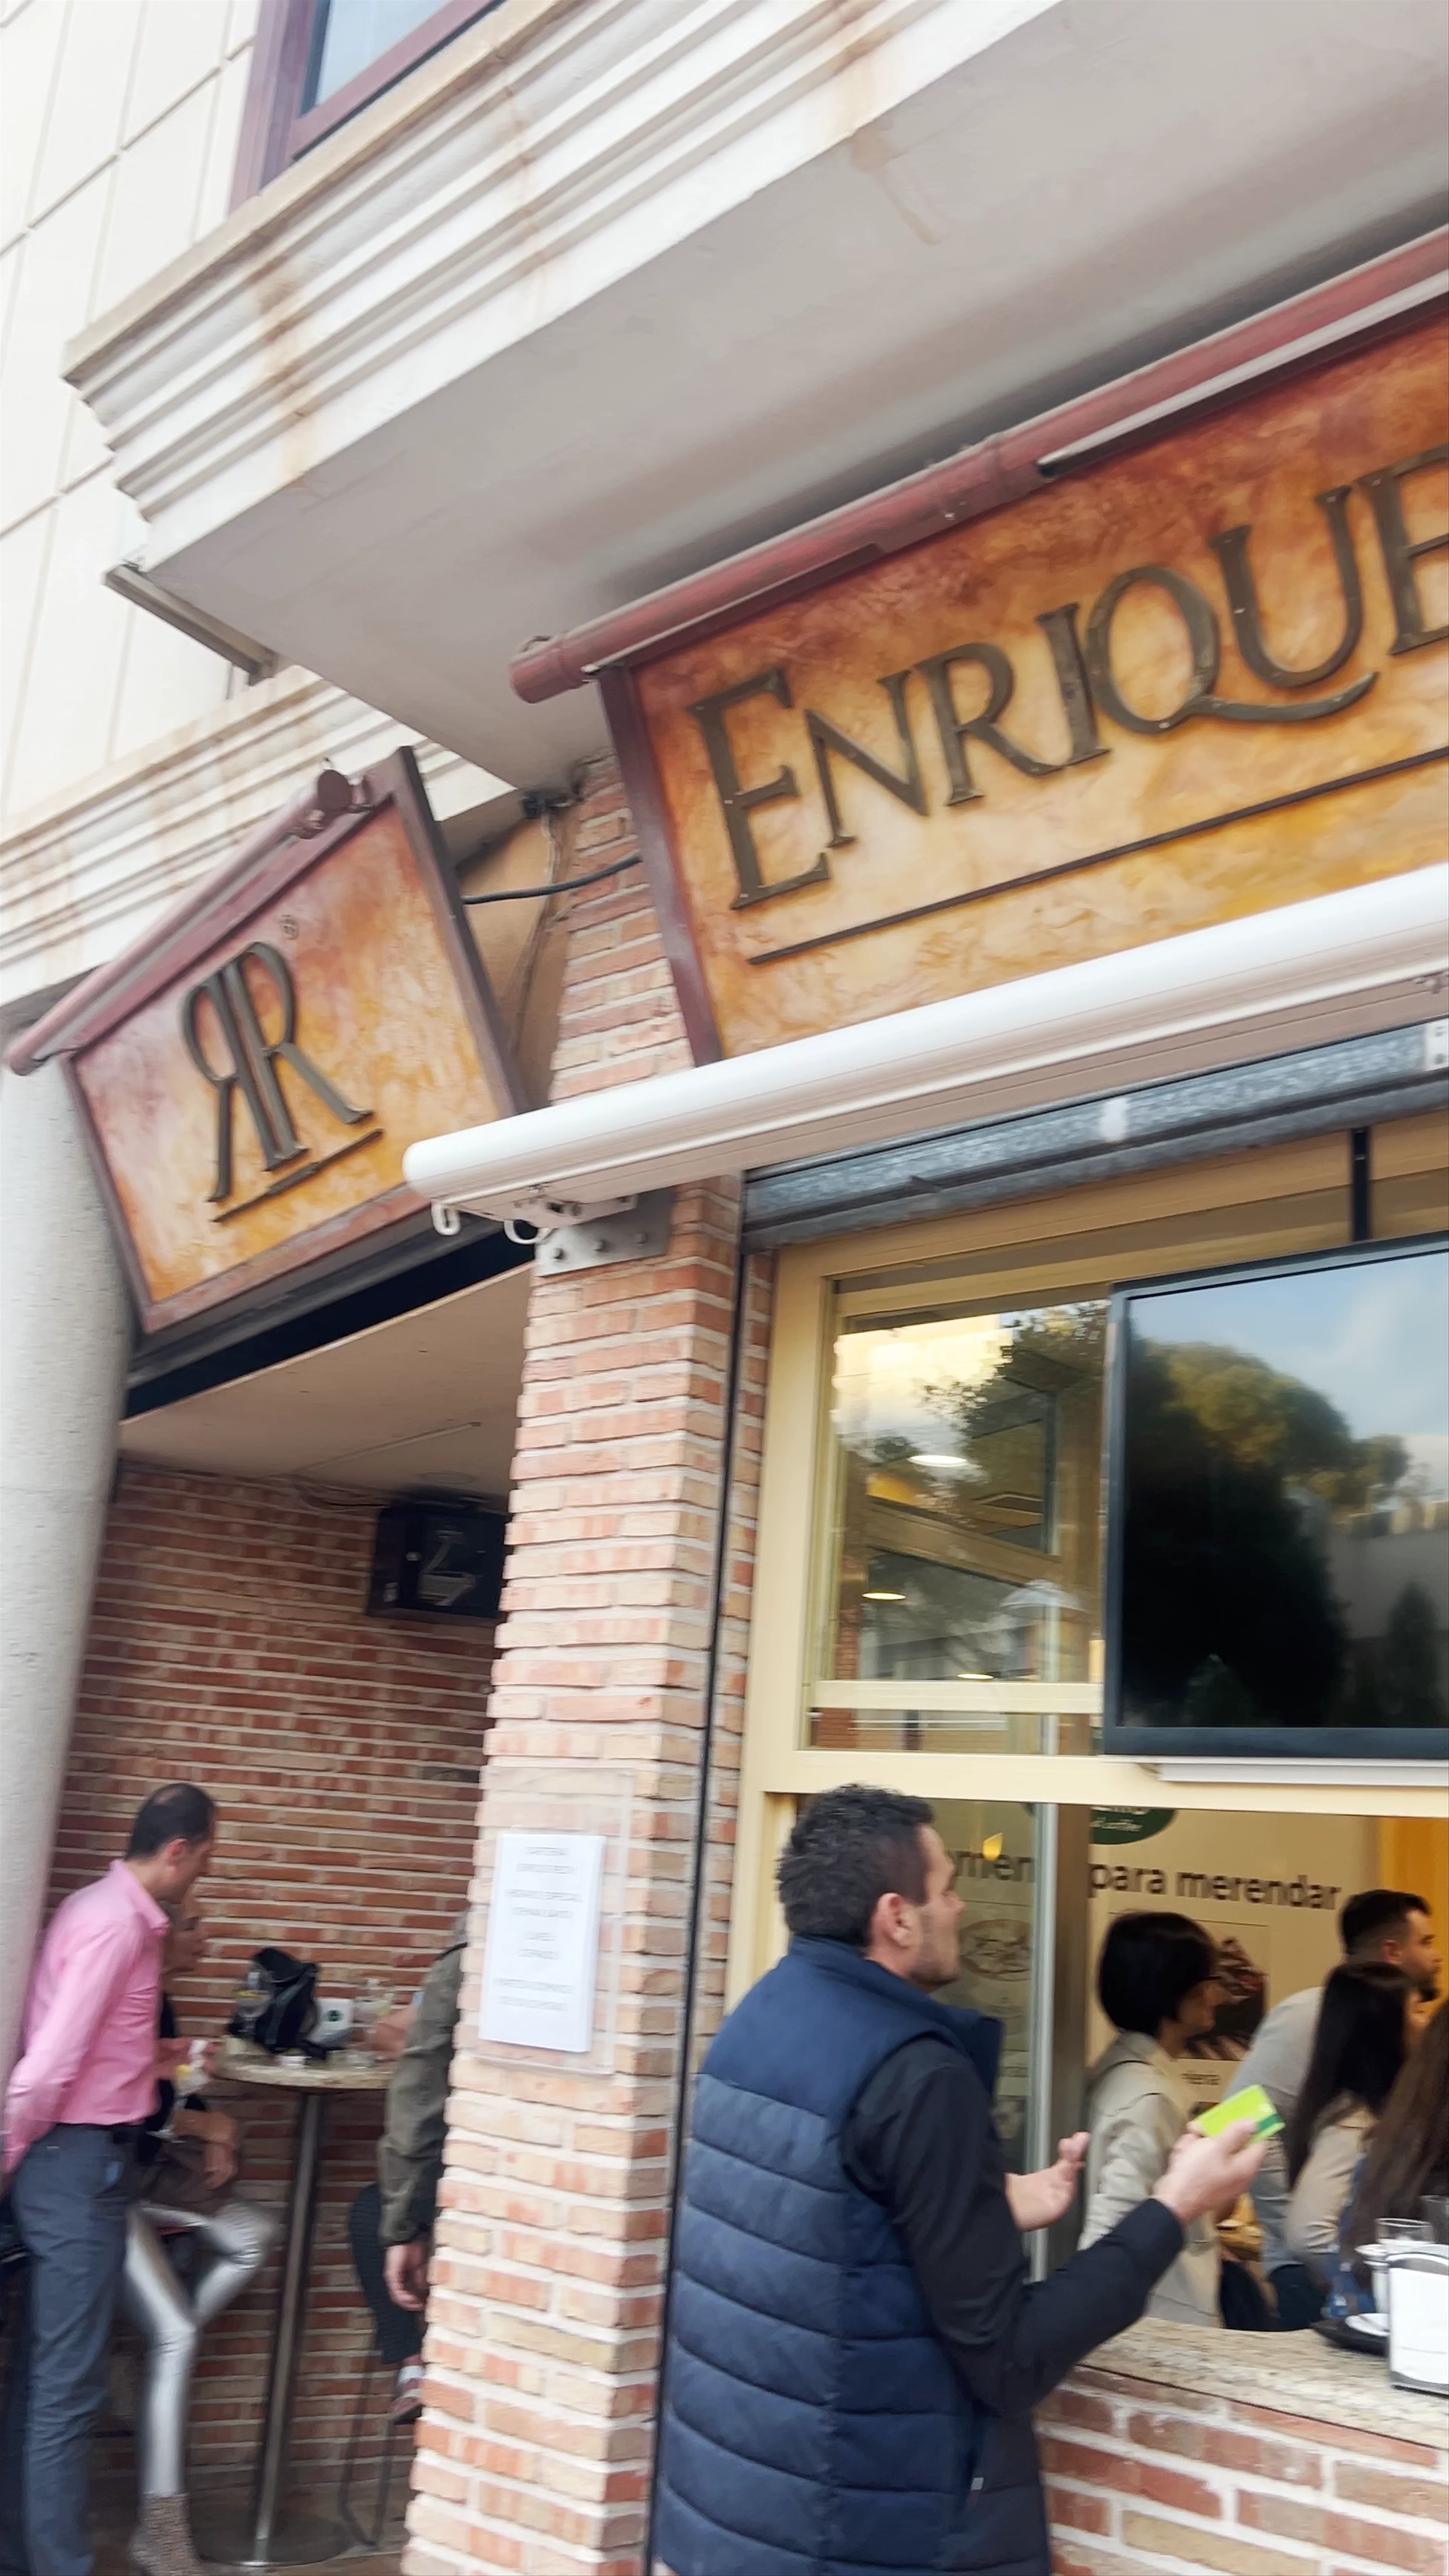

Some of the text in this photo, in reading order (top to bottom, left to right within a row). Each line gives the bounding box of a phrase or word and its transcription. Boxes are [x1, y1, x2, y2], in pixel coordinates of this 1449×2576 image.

[685, 442, 1449, 910] ENRIQUE
[1088, 1863, 1168, 1898] para
[1176, 1872, 1341, 1910] merendar
